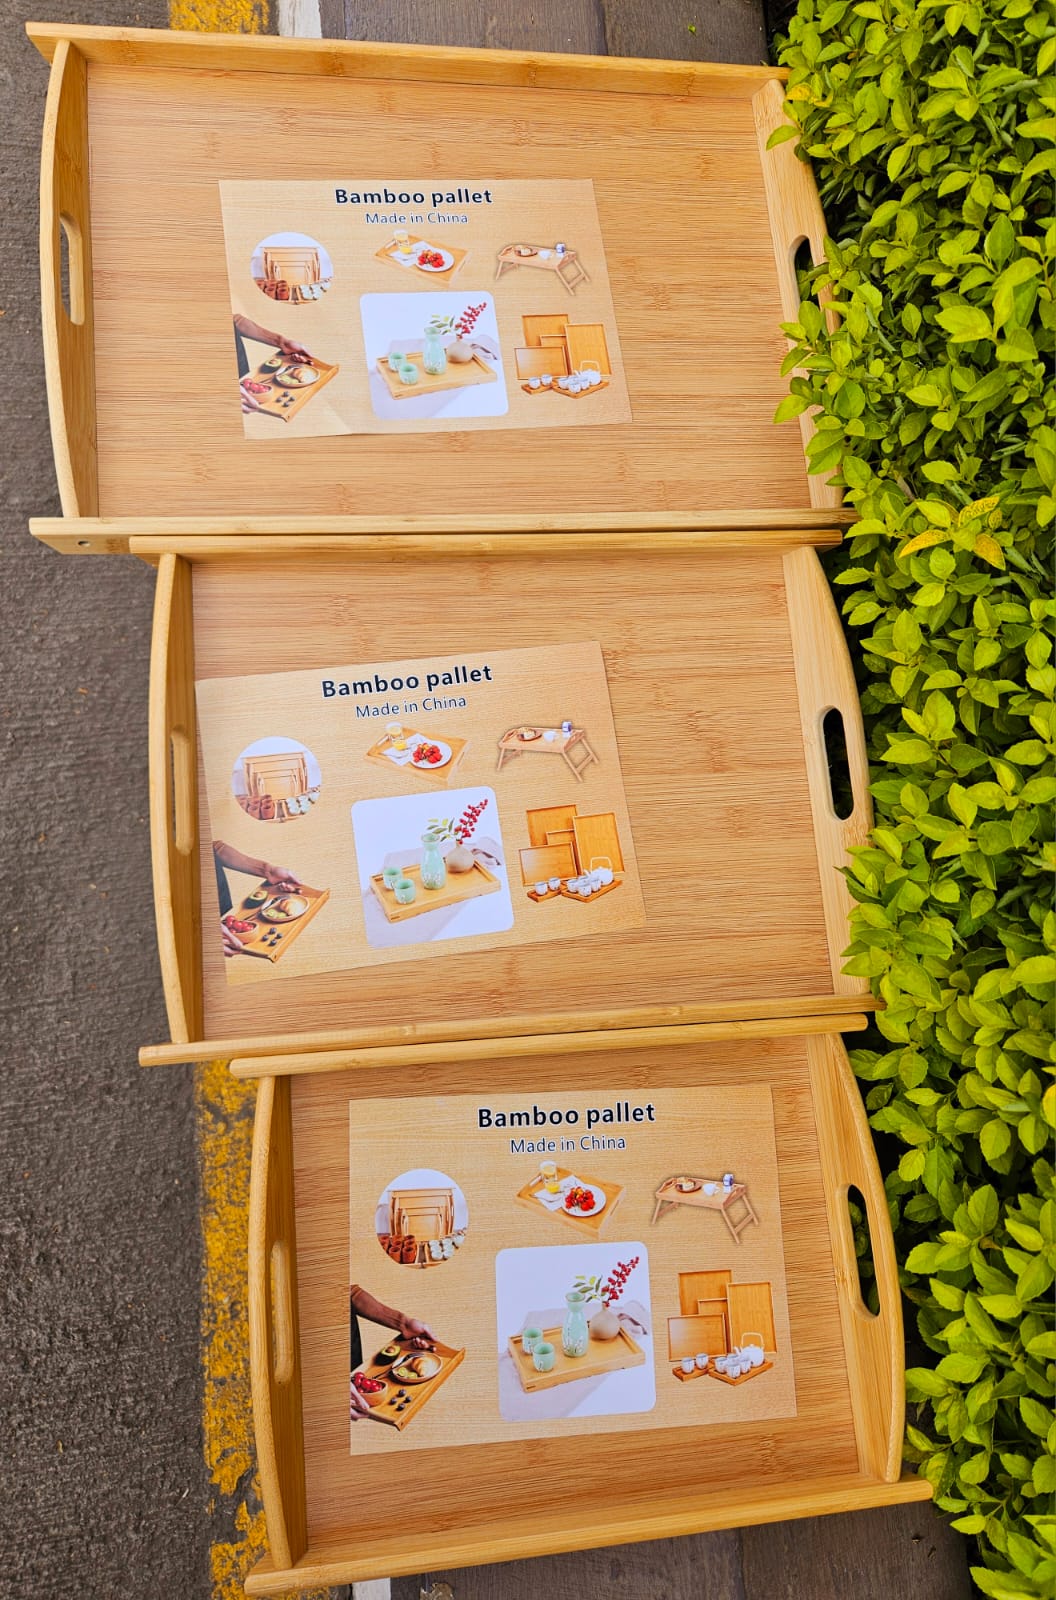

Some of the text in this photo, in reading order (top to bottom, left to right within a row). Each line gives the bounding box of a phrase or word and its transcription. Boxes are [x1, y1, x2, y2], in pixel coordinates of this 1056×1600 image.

[335, 188, 493, 208] Bamboo pallet
[365, 212, 468, 224] Made in China
[322, 665, 493, 698] Bamboo pallet
[356, 697, 467, 718] Made in China
[478, 1102, 656, 1129] Bamboo pallet
[510, 1136, 626, 1154] Made in China
